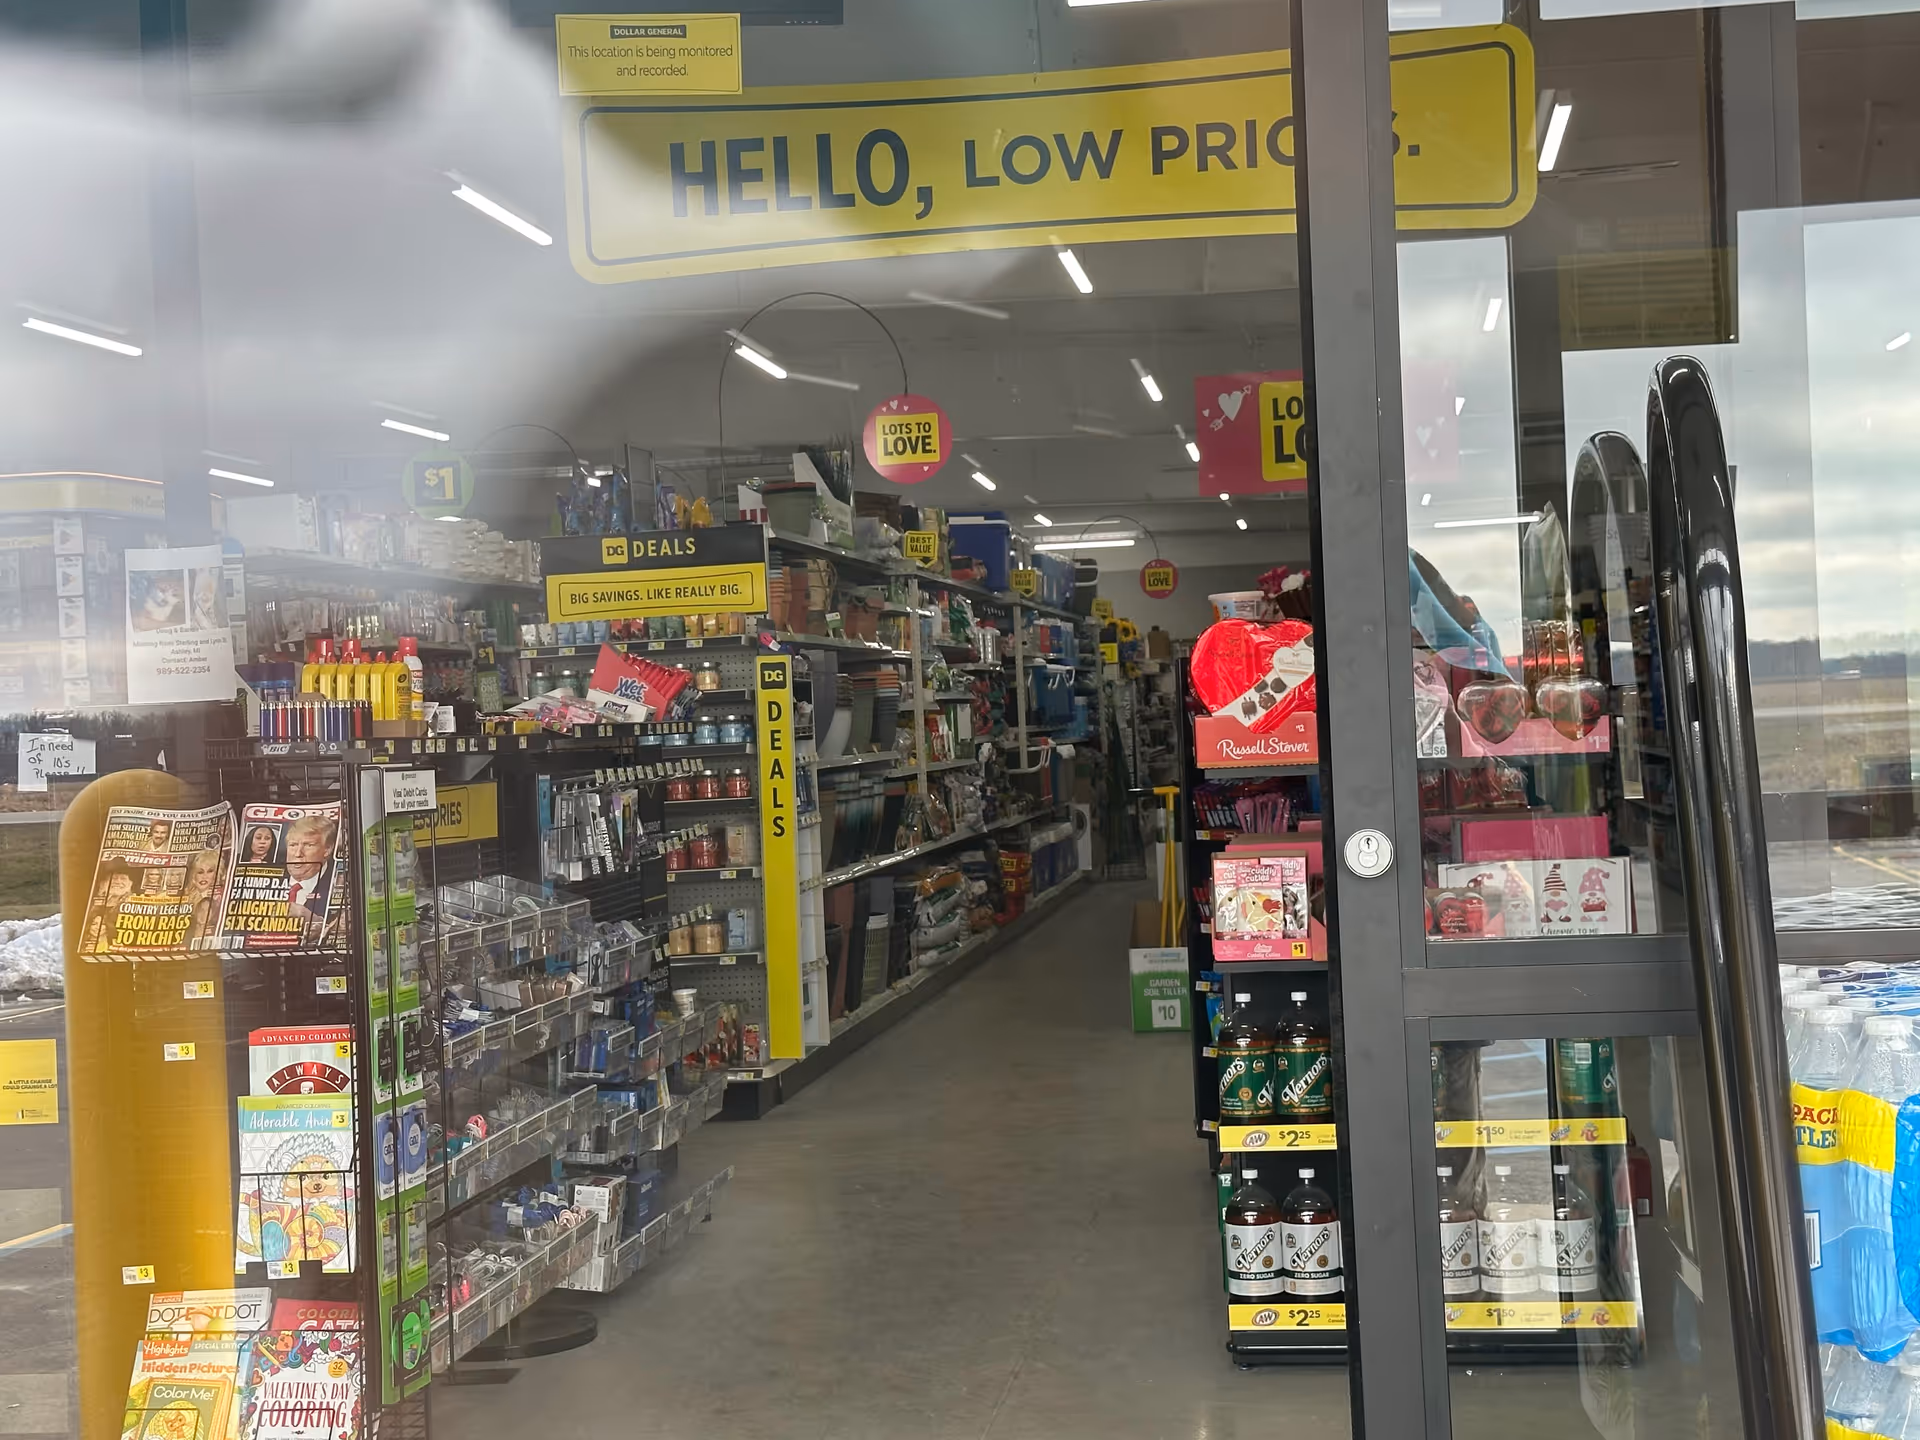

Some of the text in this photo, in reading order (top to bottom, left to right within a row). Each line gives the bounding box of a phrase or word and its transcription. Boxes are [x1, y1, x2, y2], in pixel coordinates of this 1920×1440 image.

[614, 28, 683, 36] DOLLAR GENERAL
[568, 45, 733, 59] This location is being monitored
[616, 64, 689, 76] and recorded.
[667, 128, 934, 220] HELLO,
[963, 129, 1124, 189] LOW
[882, 421, 931, 436] LOTS TO
[883, 435, 937, 457] LOVE.
[424, 467, 455, 500] $1
[910, 536, 932, 544] BEST
[605, 537, 697, 558] DG DEALS
[910, 544, 932, 554] VALUE
[570, 583, 743, 605] BIG SAVINGS. LIKE REALLY BIG.
[478, 646, 495, 664] $1
[763, 669, 784, 683] DG
[619, 676, 648, 695] Wet
[268, 744, 289, 753] BIC
[1217, 737, 1309, 760] Russell Stover
[1433, 746, 1446, 755] $6
[53, 756, 71, 768] 10's
[767, 700, 786, 838] DEALS
[403, 788, 415, 797] Debit
[415, 787, 428, 797] Cards
[406, 801, 416, 810] your
[416, 799, 429, 807] needs
[121, 824, 151, 833] SELLECK'S
[174, 828, 192, 836] WHAT
[107, 831, 149, 841] AMAZING LIFE
[173, 834, 208, 844] ELVIS IN THE
[112, 841, 139, 849] PHOTOS!
[271, 877, 292, 889] D.A.
[255, 889, 291, 900] WILLIS
[119, 902, 194, 915] COUNTRY LEGENDS
[274, 901, 291, 917] IN
[115, 914, 192, 930] FROM RAGS
[247, 916, 306, 932] SCANDAL!
[116, 929, 135, 945] TO
[1293, 943, 1304, 954] $1
[200, 983, 209, 993] $3
[332, 978, 342, 989] $3
[1150, 979, 1180, 987] GARDEN
[1144, 987, 1187, 996] SOIL TILLER
[262, 1035, 306, 1043] ADVANCED
[180, 1045, 190, 1055] $3
[339, 1045, 349, 1054] $5
[272, 1064, 345, 1089] ALWAYS
[1281, 1052, 1328, 1104] Vernors
[249, 1111, 300, 1130] Adorable
[336, 1114, 345, 1124] $3
[1220, 1175, 1232, 1186] 12
[1235, 1226, 1276, 1271] Vernors
[1290, 1226, 1331, 1271] Vernors
[1485, 1223, 1528, 1268] Vernors
[139, 1267, 149, 1278] $3
[285, 1263, 294, 1273] $3
[149, 1303, 262, 1324] DOT DOT
[144, 1342, 189, 1356] Highlights
[141, 1361, 187, 1373] Hidden
[332, 1361, 344, 1371] 32
[153, 1386, 216, 1401] Color Me!
[263, 1382, 352, 1400] VALENTINE'S DAY
[258, 1400, 348, 1429] COLORING
